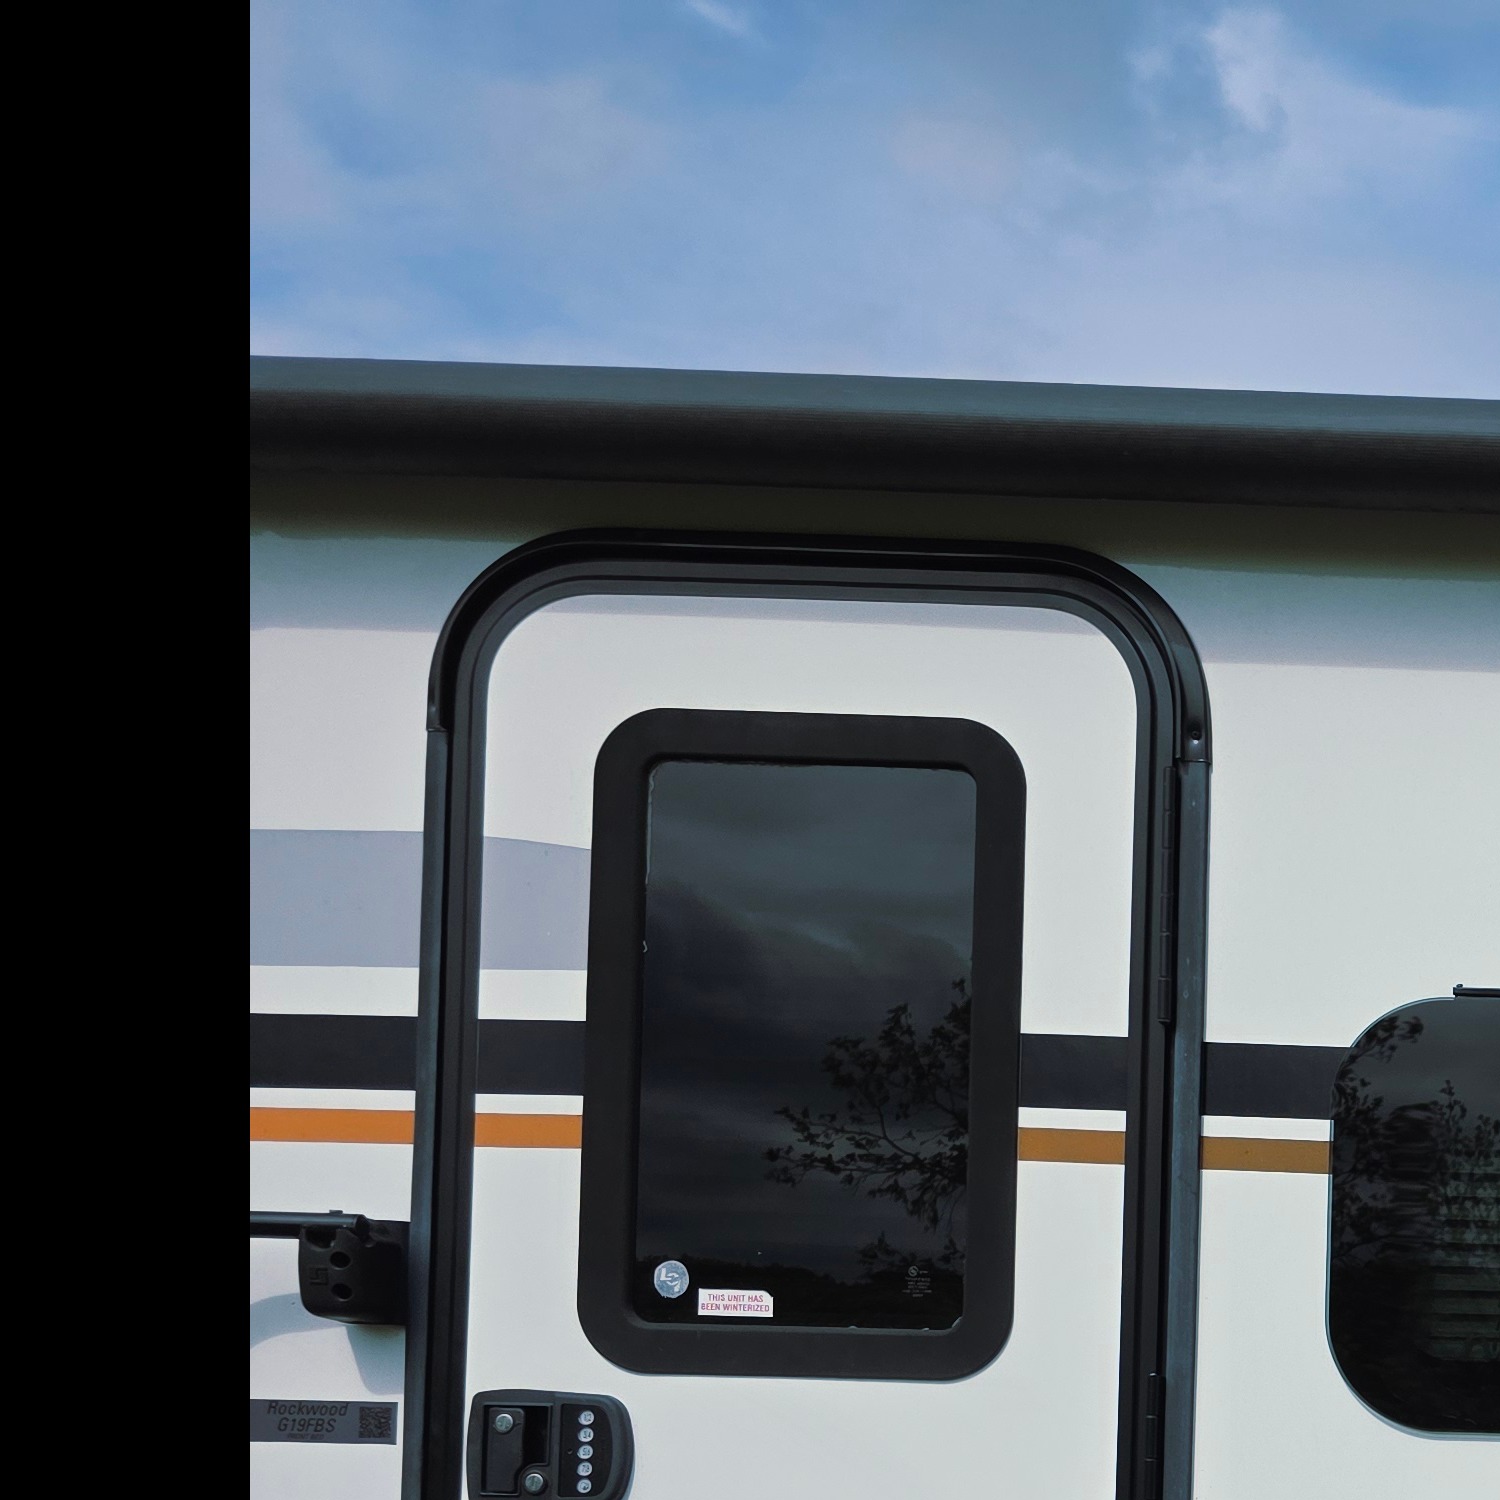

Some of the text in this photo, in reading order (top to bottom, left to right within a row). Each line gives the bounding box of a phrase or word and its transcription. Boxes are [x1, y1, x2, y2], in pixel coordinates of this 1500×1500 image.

[708, 1294, 763, 1303] THIS UNIT HAS
[701, 1303, 770, 1313] BEEN WINTERIZED
[267, 1401, 349, 1416] Rockwood
[277, 1417, 337, 1433] G19FBS
